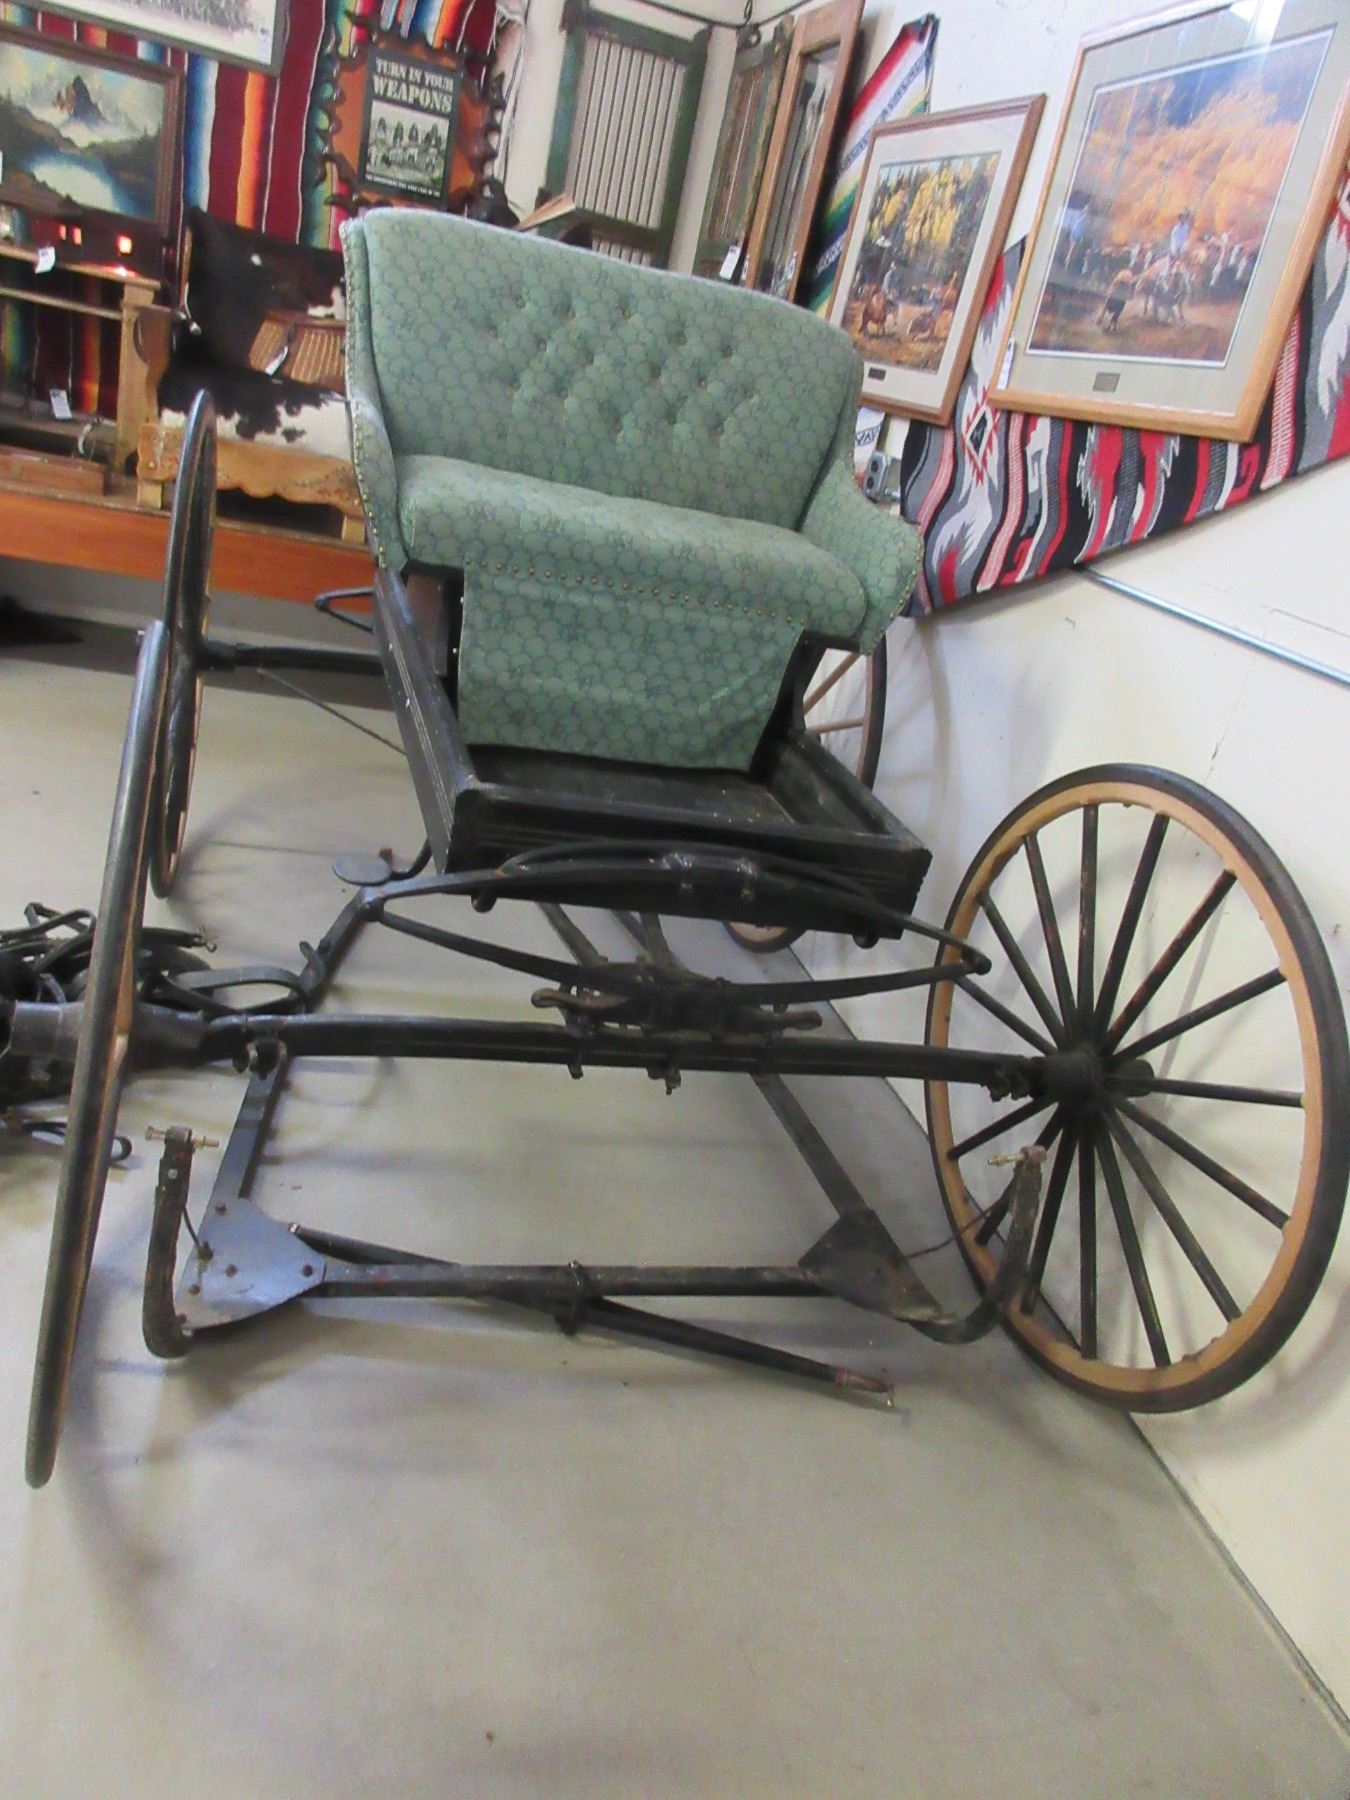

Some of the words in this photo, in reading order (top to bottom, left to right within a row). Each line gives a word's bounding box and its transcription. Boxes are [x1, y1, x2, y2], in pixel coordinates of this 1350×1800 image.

[376, 58, 407, 79] TURN
[409, 66, 422, 84] IN
[424, 72, 454, 92] YOUR
[373, 76, 453, 114] WEAPONS
